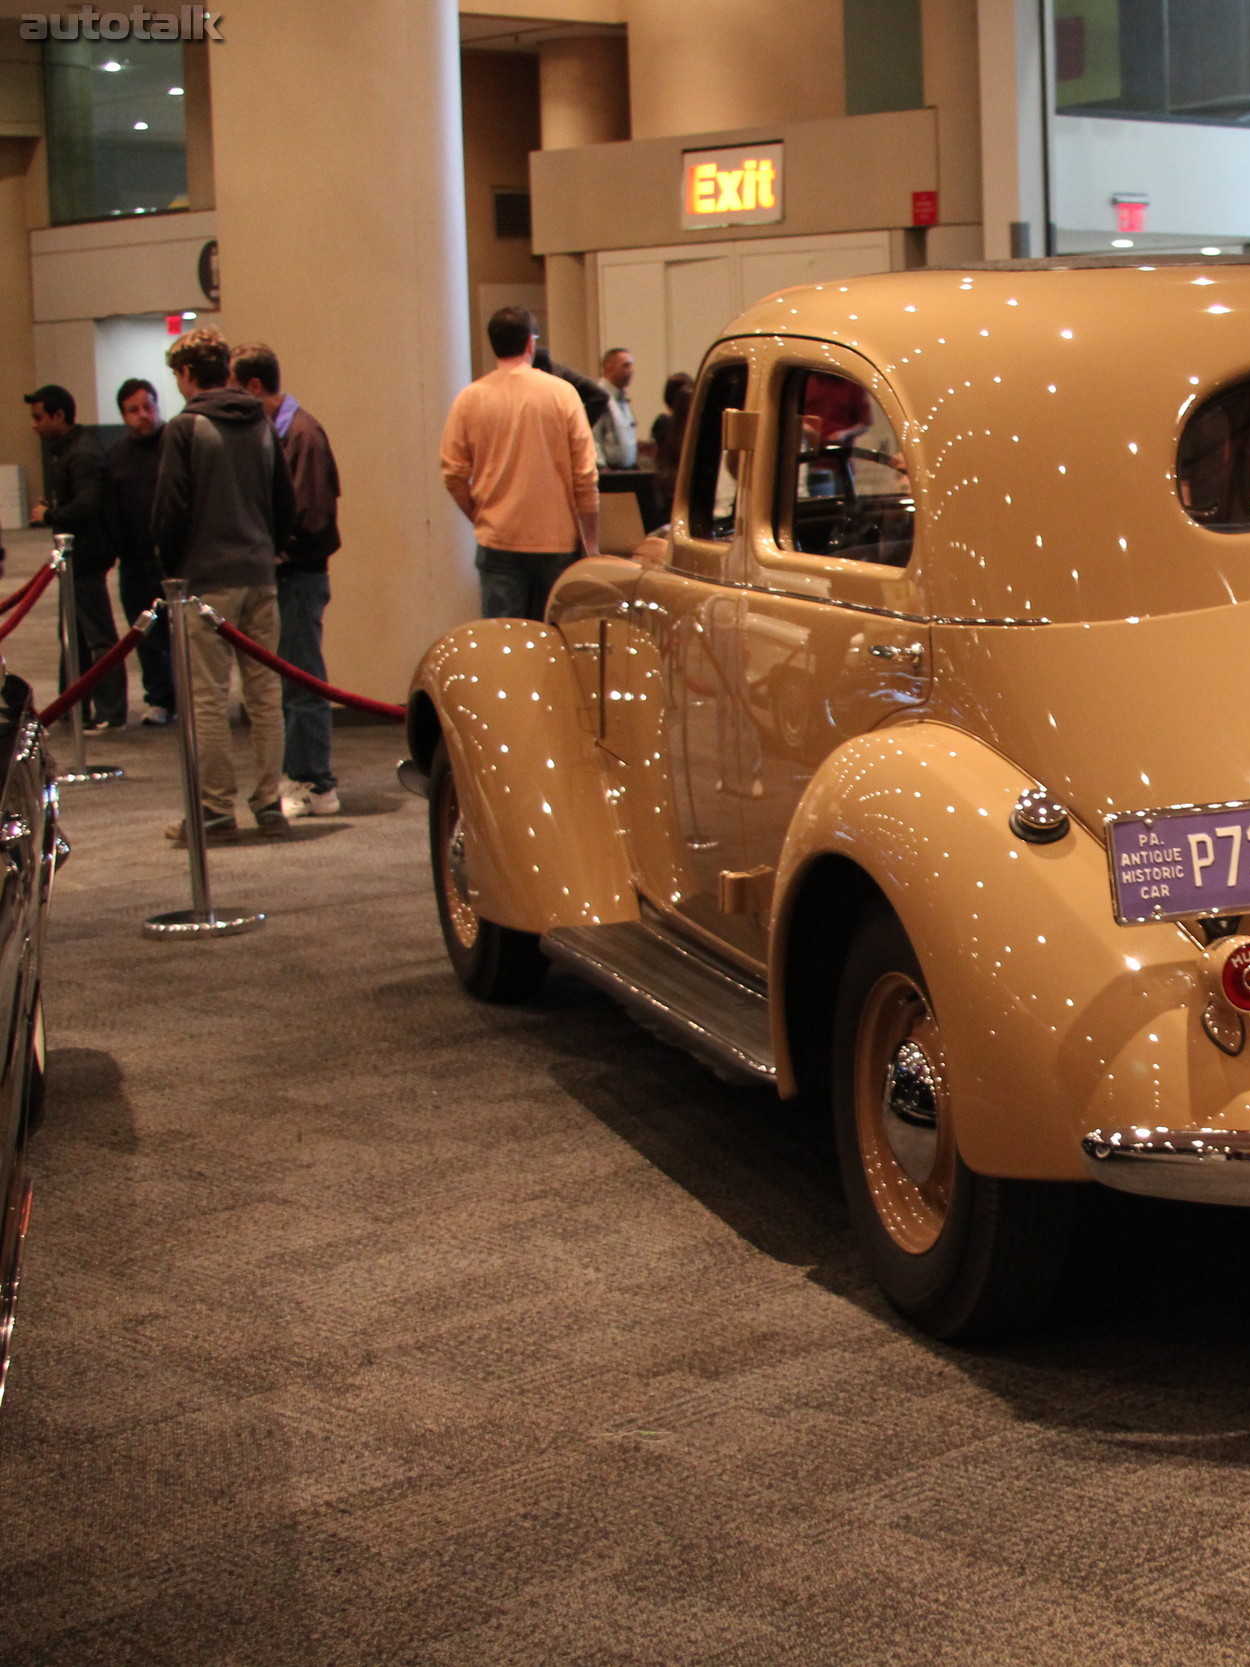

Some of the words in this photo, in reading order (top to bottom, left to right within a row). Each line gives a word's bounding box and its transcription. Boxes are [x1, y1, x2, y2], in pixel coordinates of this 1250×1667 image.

[686, 159, 776, 215] Exit
[1138, 832, 1165, 847] PA.
[1120, 848, 1183, 867] ANTIQUE
[1122, 866, 1185, 884] HISTORIC
[1140, 884, 1170, 899] CAR
